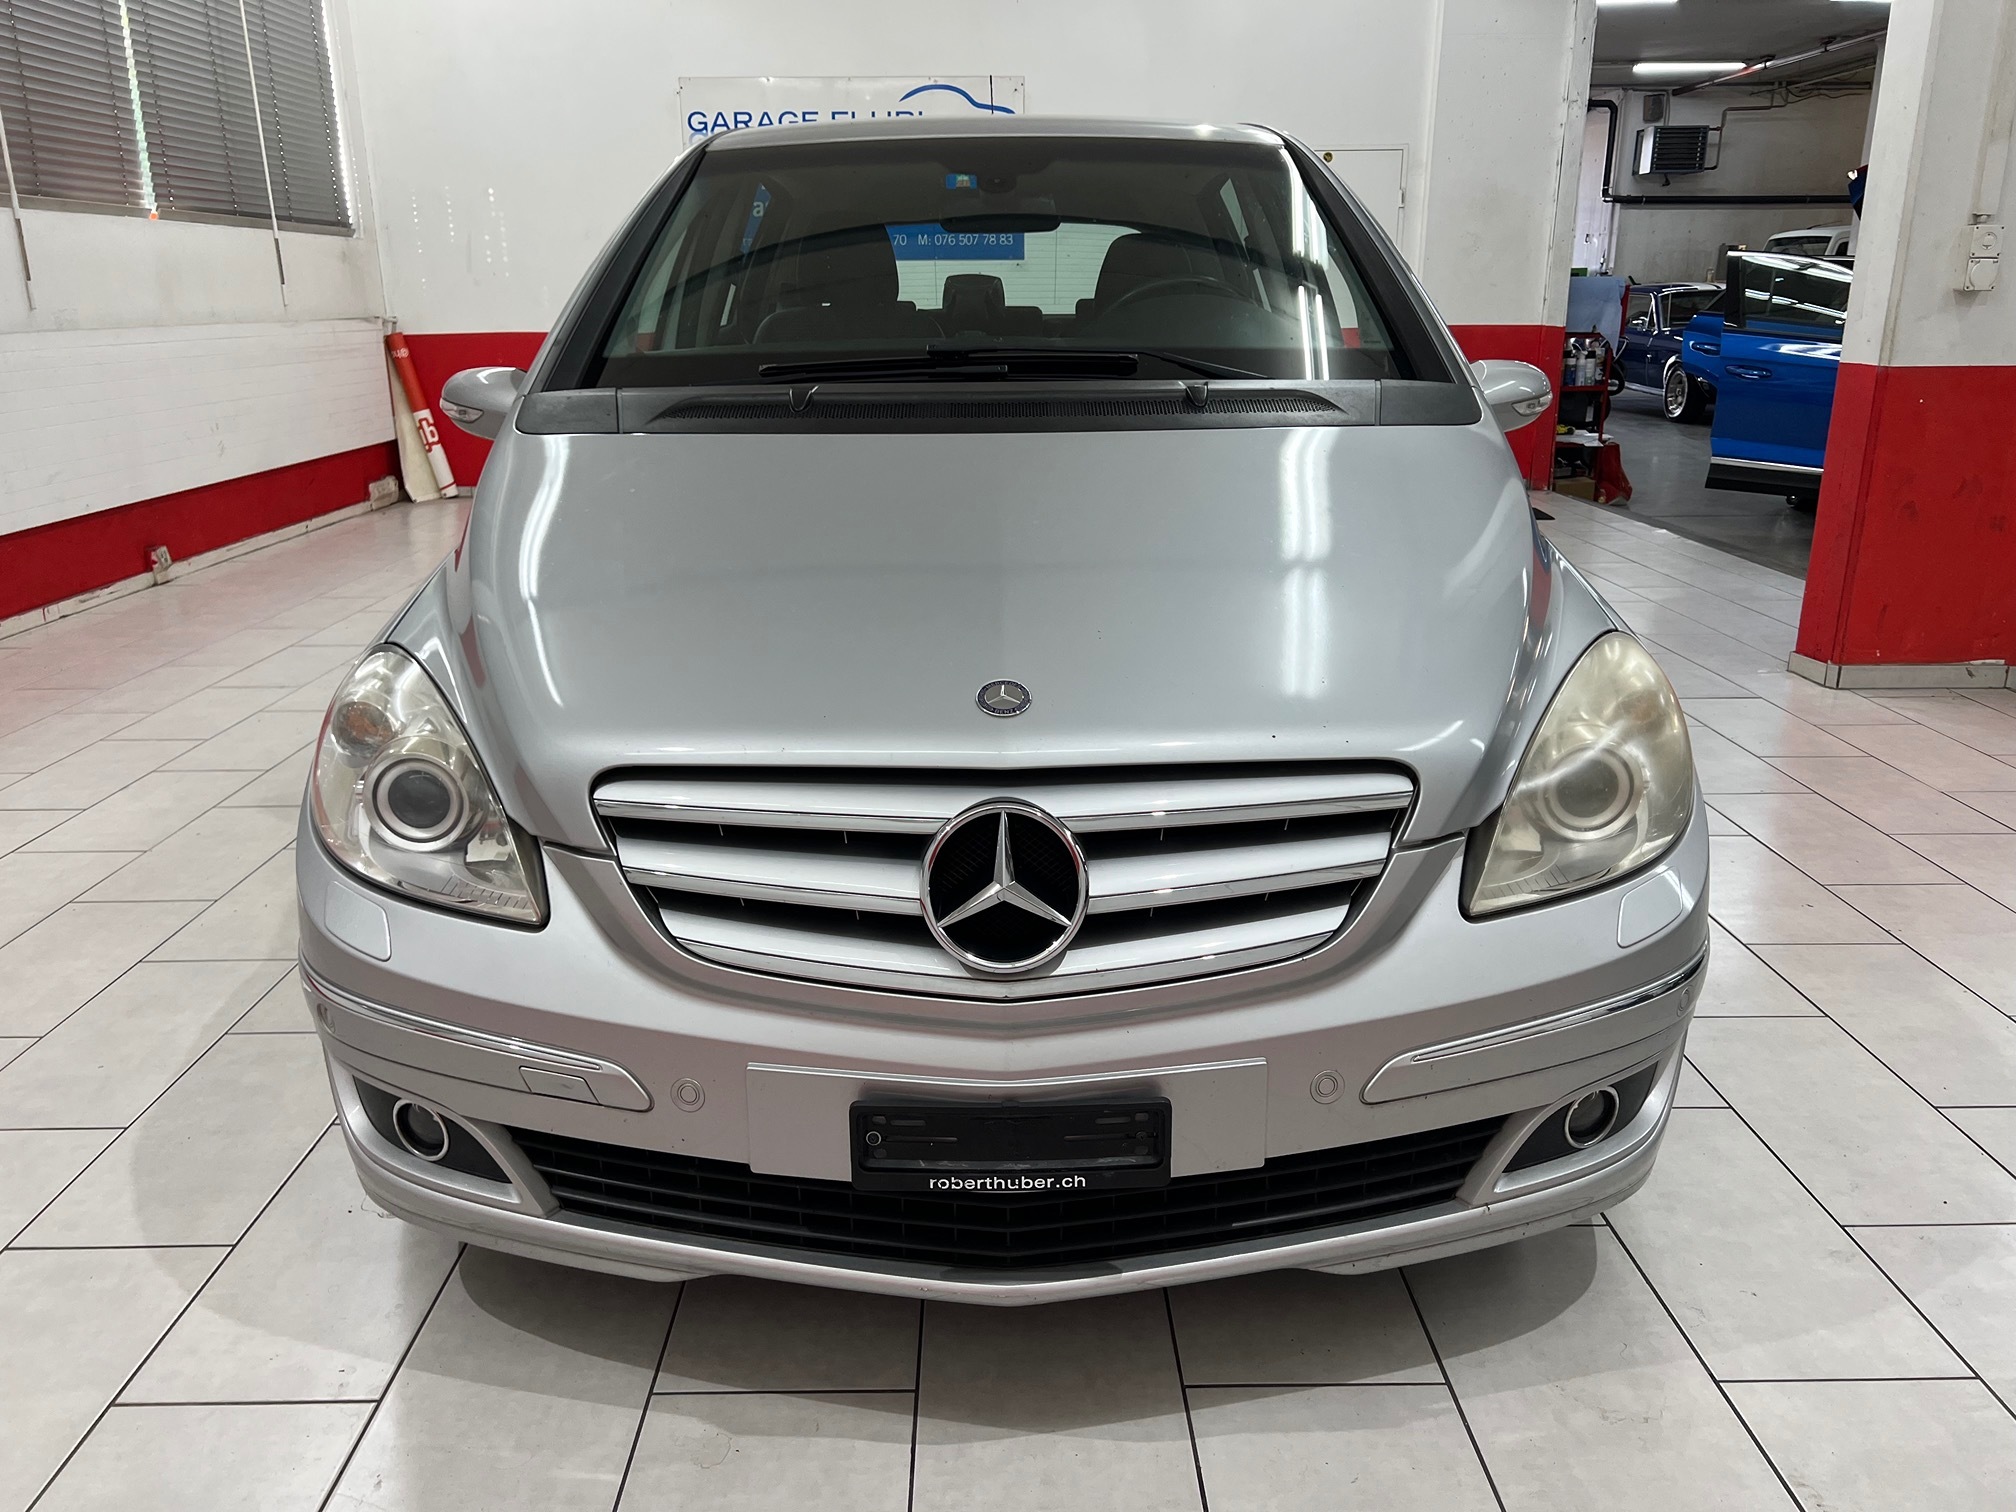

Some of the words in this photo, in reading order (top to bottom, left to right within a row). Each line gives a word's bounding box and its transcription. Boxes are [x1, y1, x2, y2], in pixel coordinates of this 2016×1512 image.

[686, 110, 819, 133] GARAGE
[893, 234, 907, 246] 70
[917, 234, 932, 246] M:
[934, 234, 956, 246] 076
[958, 234, 979, 246] 507
[983, 234, 997, 246] 78
[999, 233, 1014, 246] 83
[929, 1175, 1086, 1190] roberthuber.ch
